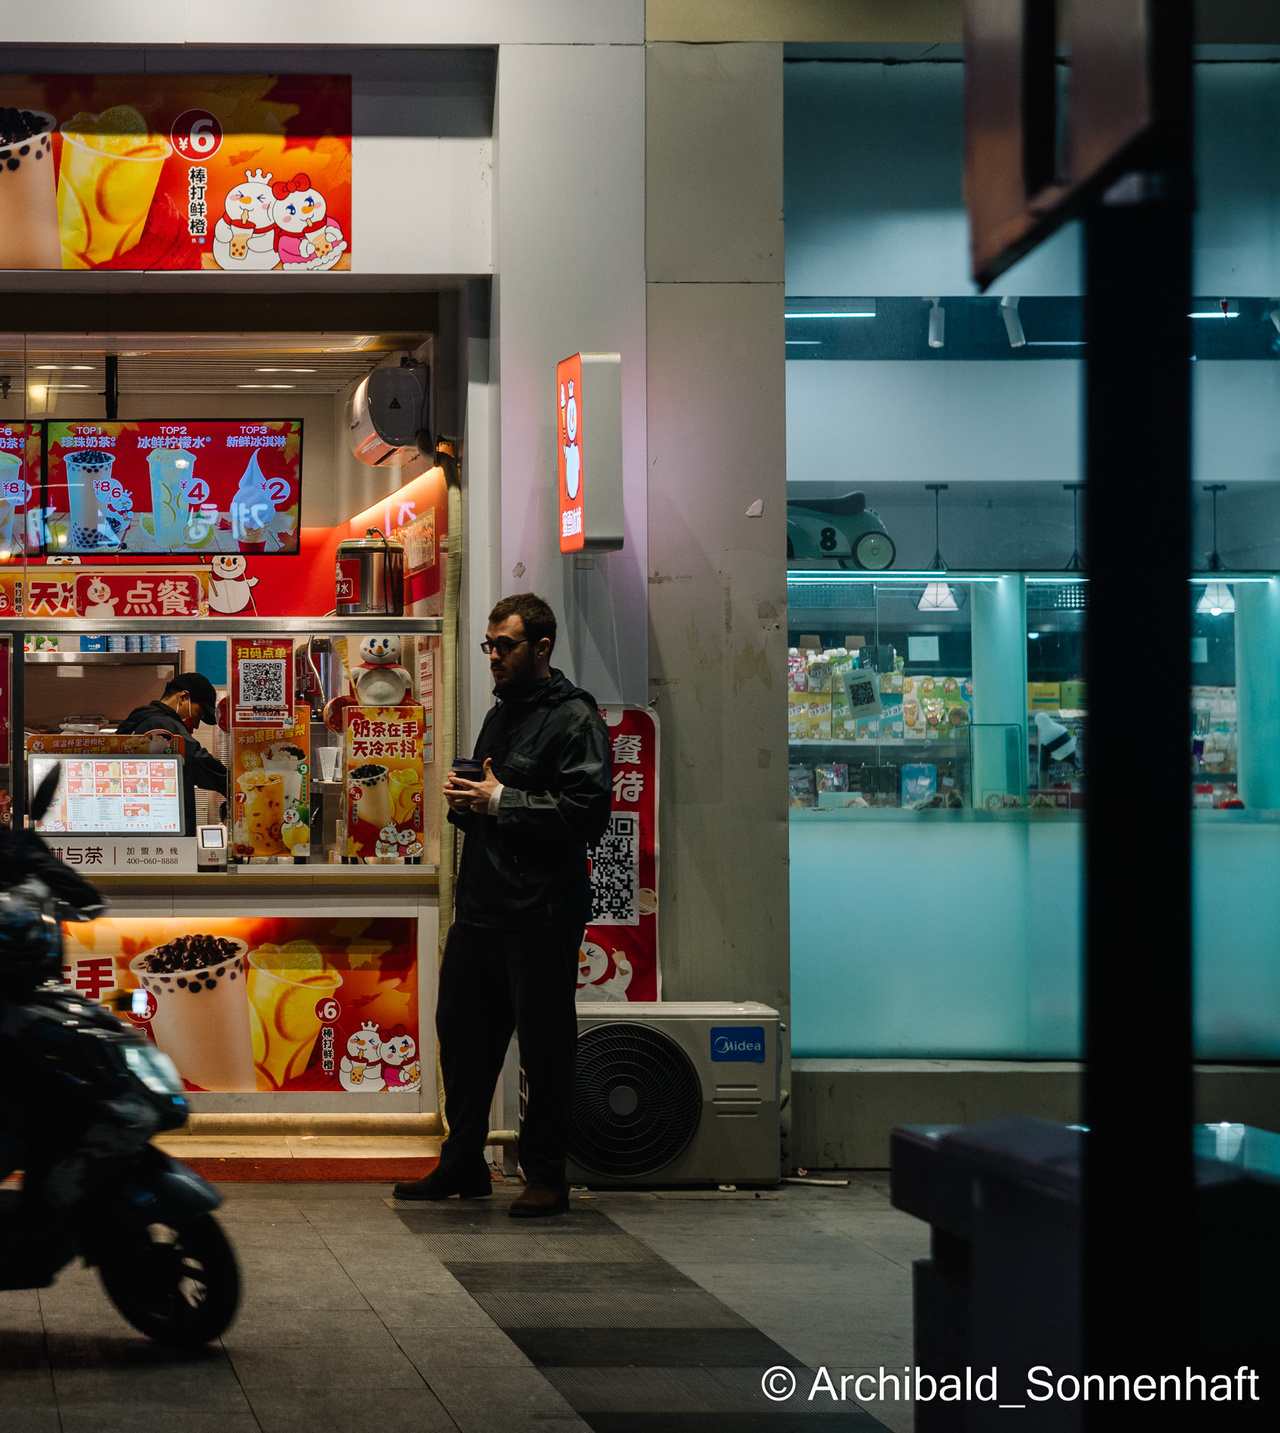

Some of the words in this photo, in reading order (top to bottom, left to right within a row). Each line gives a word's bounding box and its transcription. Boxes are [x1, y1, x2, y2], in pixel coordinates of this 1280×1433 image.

[189, 167, 206, 235] 棒打鲜橙
[76, 426, 102, 435] TOP1
[159, 426, 187, 435] TOP2
[240, 425, 268, 434] TOP3
[60, 436, 111, 448] 珍珠奶茶
[137, 436, 205, 449] 冰鲜柠檬水
[226, 435, 287, 448] 新鲜冰淇淋
[820, 526, 837, 551] 8
[123, 579, 191, 615] 点餐
[237, 647, 287, 659] 扫码点单
[352, 719, 418, 738] 奶茶在手
[352, 739, 418, 758] 天冷不抖
[322, 1027, 334, 1070] 棒打鲜橙
[718, 1038, 761, 1052] Midea
